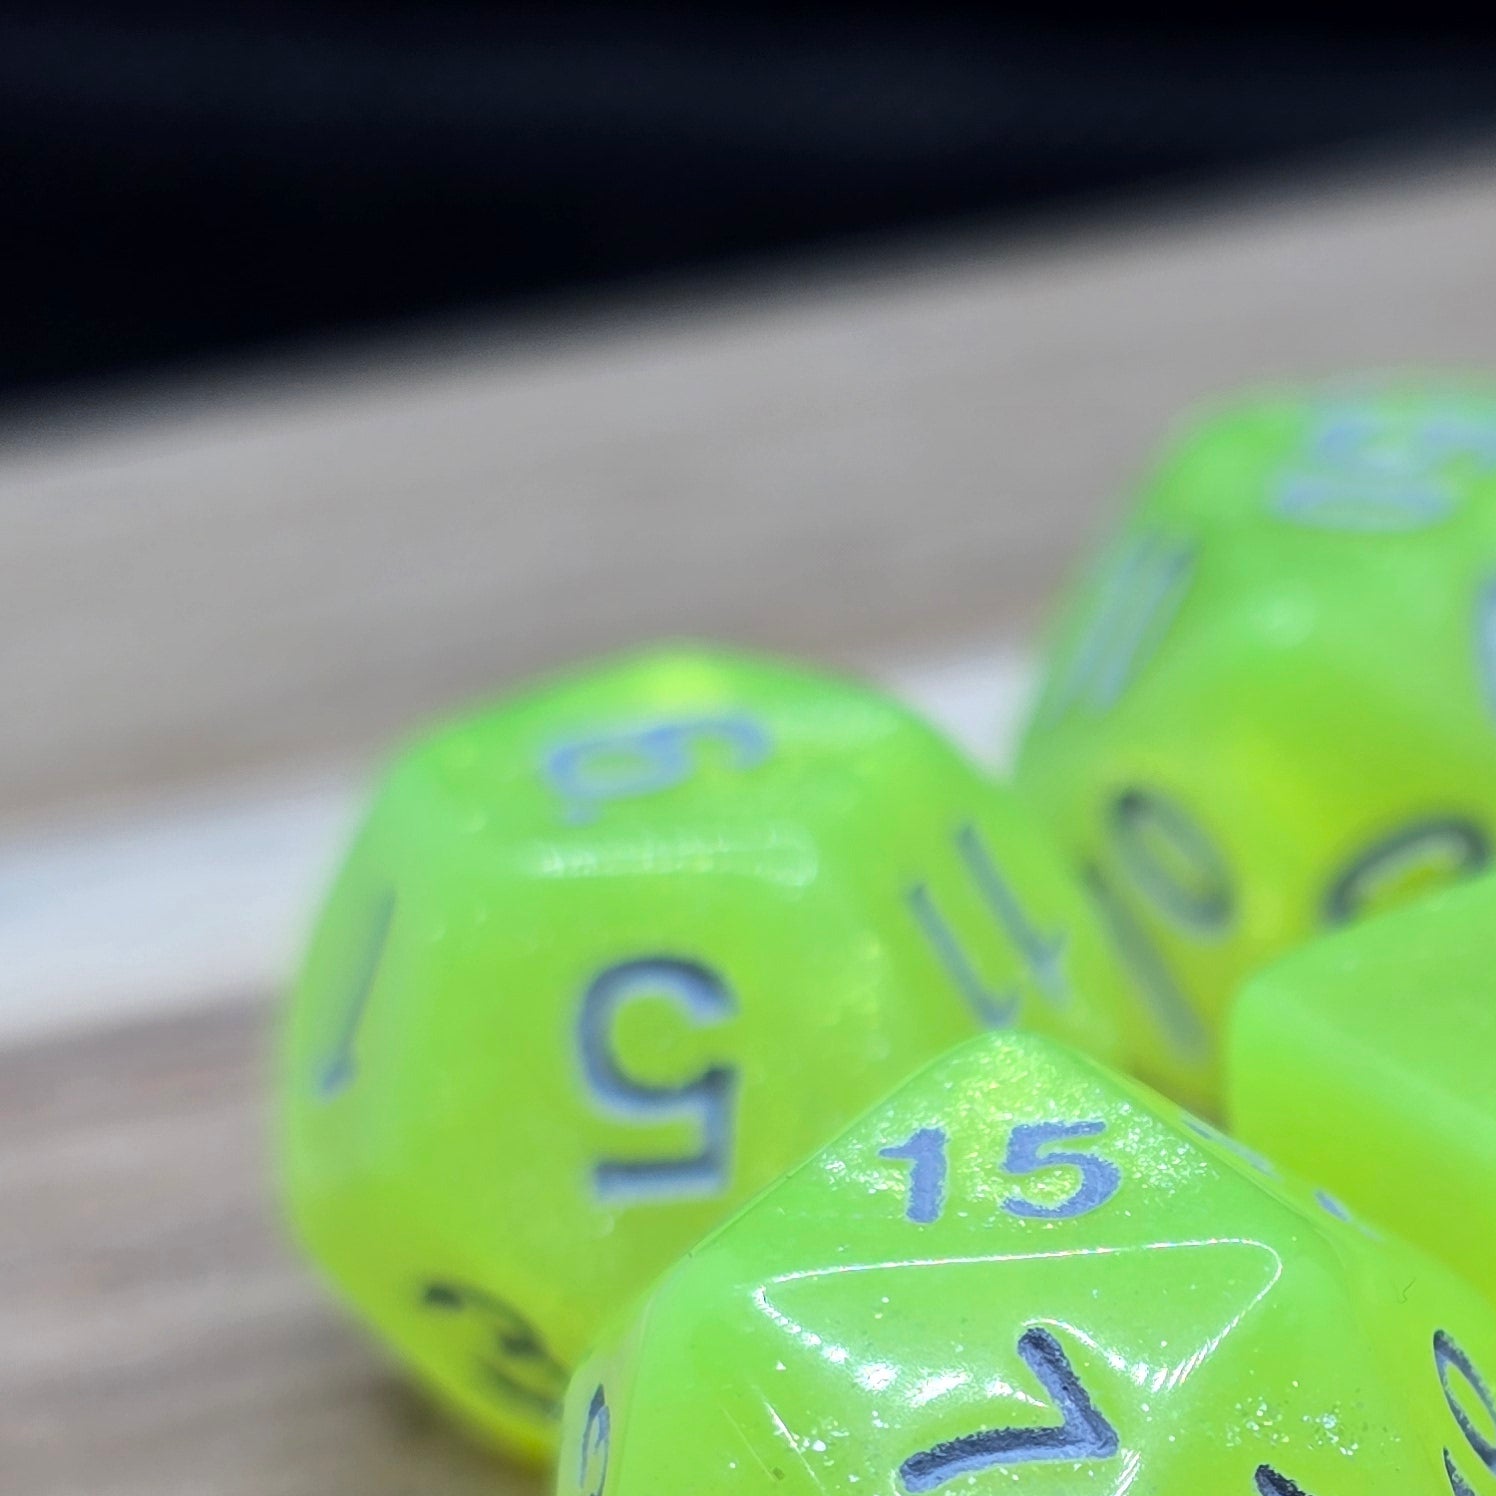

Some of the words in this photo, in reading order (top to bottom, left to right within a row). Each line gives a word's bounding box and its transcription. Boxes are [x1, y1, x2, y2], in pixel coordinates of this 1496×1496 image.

[573, 952, 741, 1204] 5
[879, 1121, 1121, 1225] 15
[900, 1327, 1120, 1493] 7
